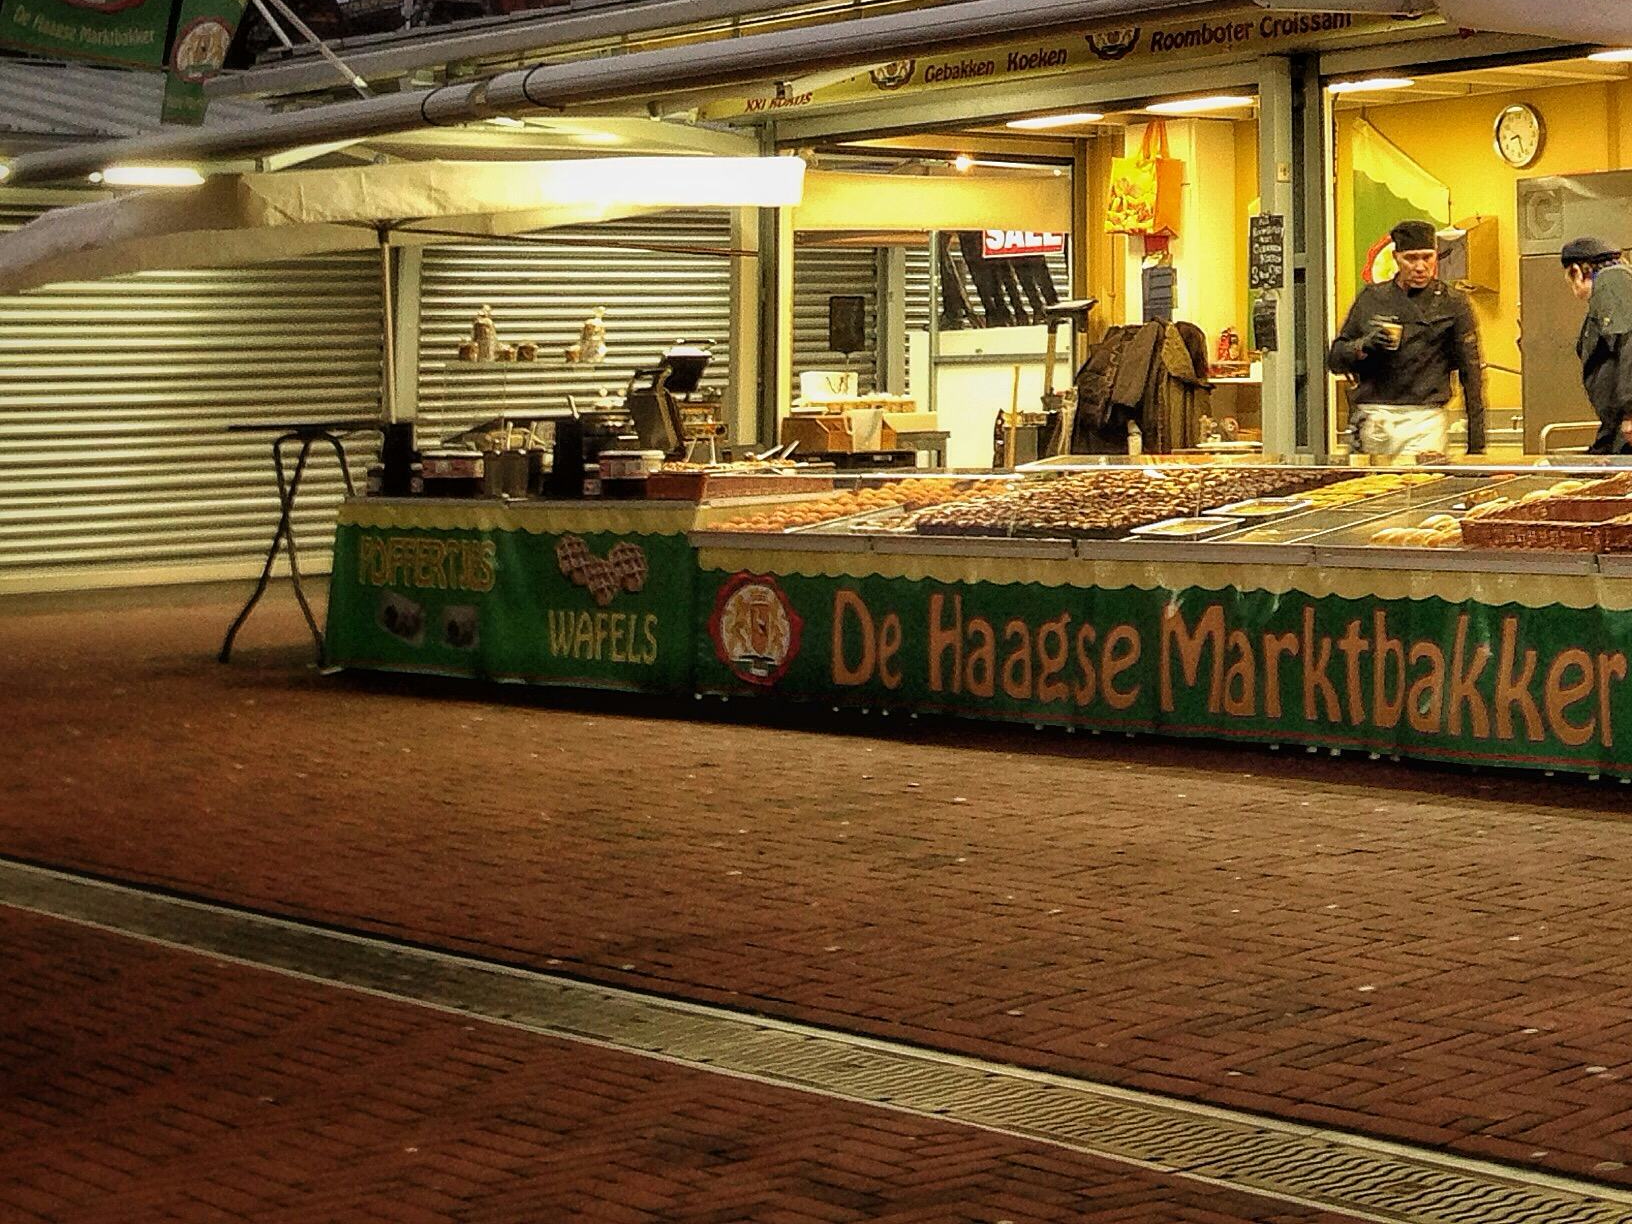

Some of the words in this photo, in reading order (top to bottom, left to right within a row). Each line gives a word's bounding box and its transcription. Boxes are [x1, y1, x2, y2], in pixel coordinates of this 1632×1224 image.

[1150, 22, 1255, 53] Roomboter
[924, 59, 996, 84] Gebakken
[1006, 47, 1068, 73] Koeken
[547, 608, 658, 666] WAFELS
[830, 589, 903, 690] De
[928, 592, 1142, 710] Haagse
[1159, 604, 1630, 749] Marktbakker
